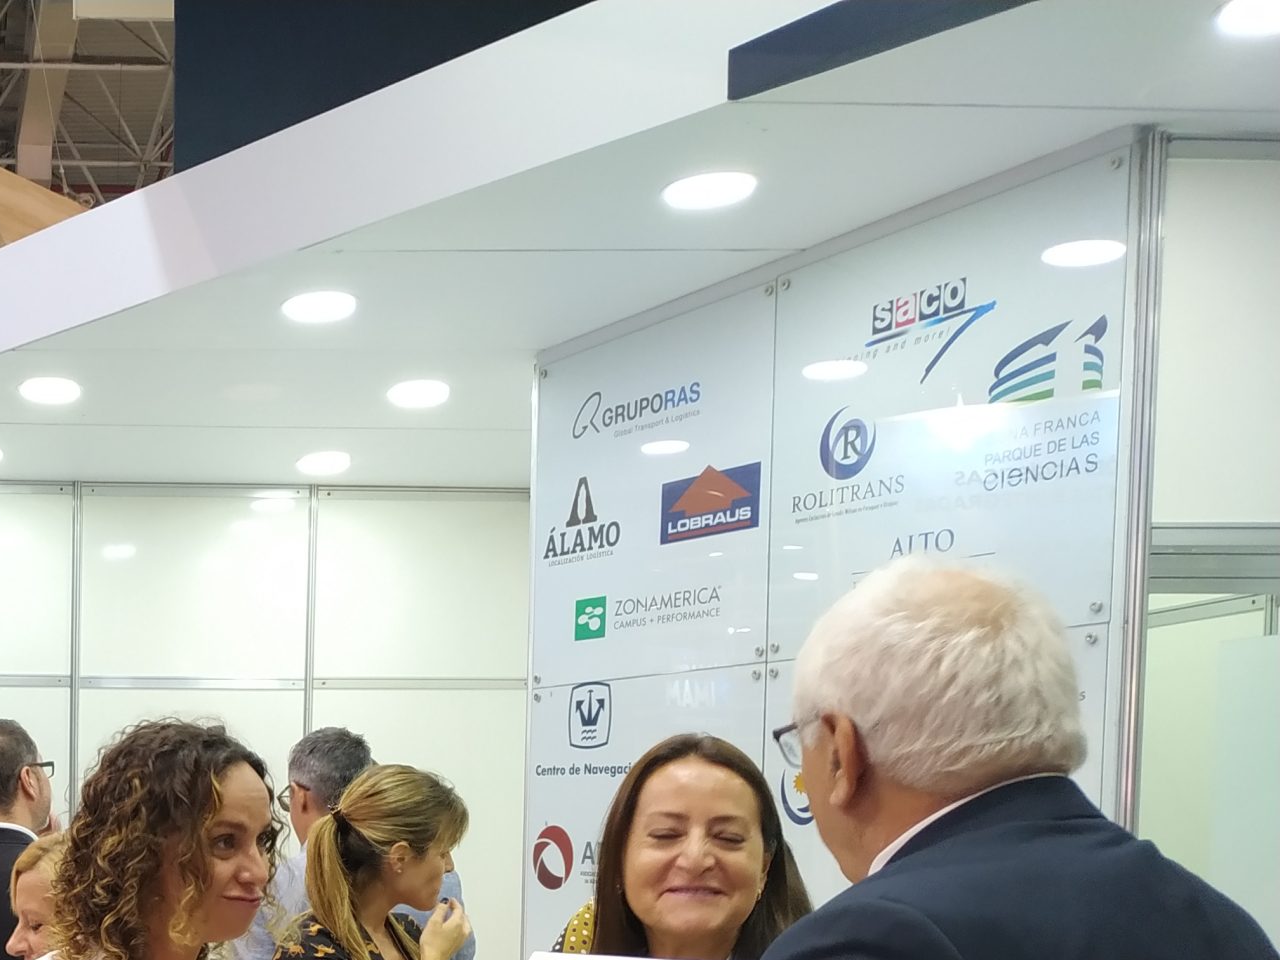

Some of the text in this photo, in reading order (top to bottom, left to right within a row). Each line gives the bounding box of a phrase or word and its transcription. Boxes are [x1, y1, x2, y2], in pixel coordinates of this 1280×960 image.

[872, 278, 966, 335] saco
[602, 382, 701, 427] GRUPORAS
[1033, 410, 1101, 437] FRANCA
[984, 431, 1100, 466] PARQUE DE LAS
[791, 474, 905, 513] ROLITRANS
[667, 506, 752, 534] LOBRAUS
[543, 521, 621, 559] ÁLAMO
[614, 586, 721, 617] ZONAMERICA
[613, 617, 647, 630] CAMPUS
[657, 607, 721, 624] PERFORMANCE
[535, 764, 566, 776] Centro
[569, 763, 581, 775] de
